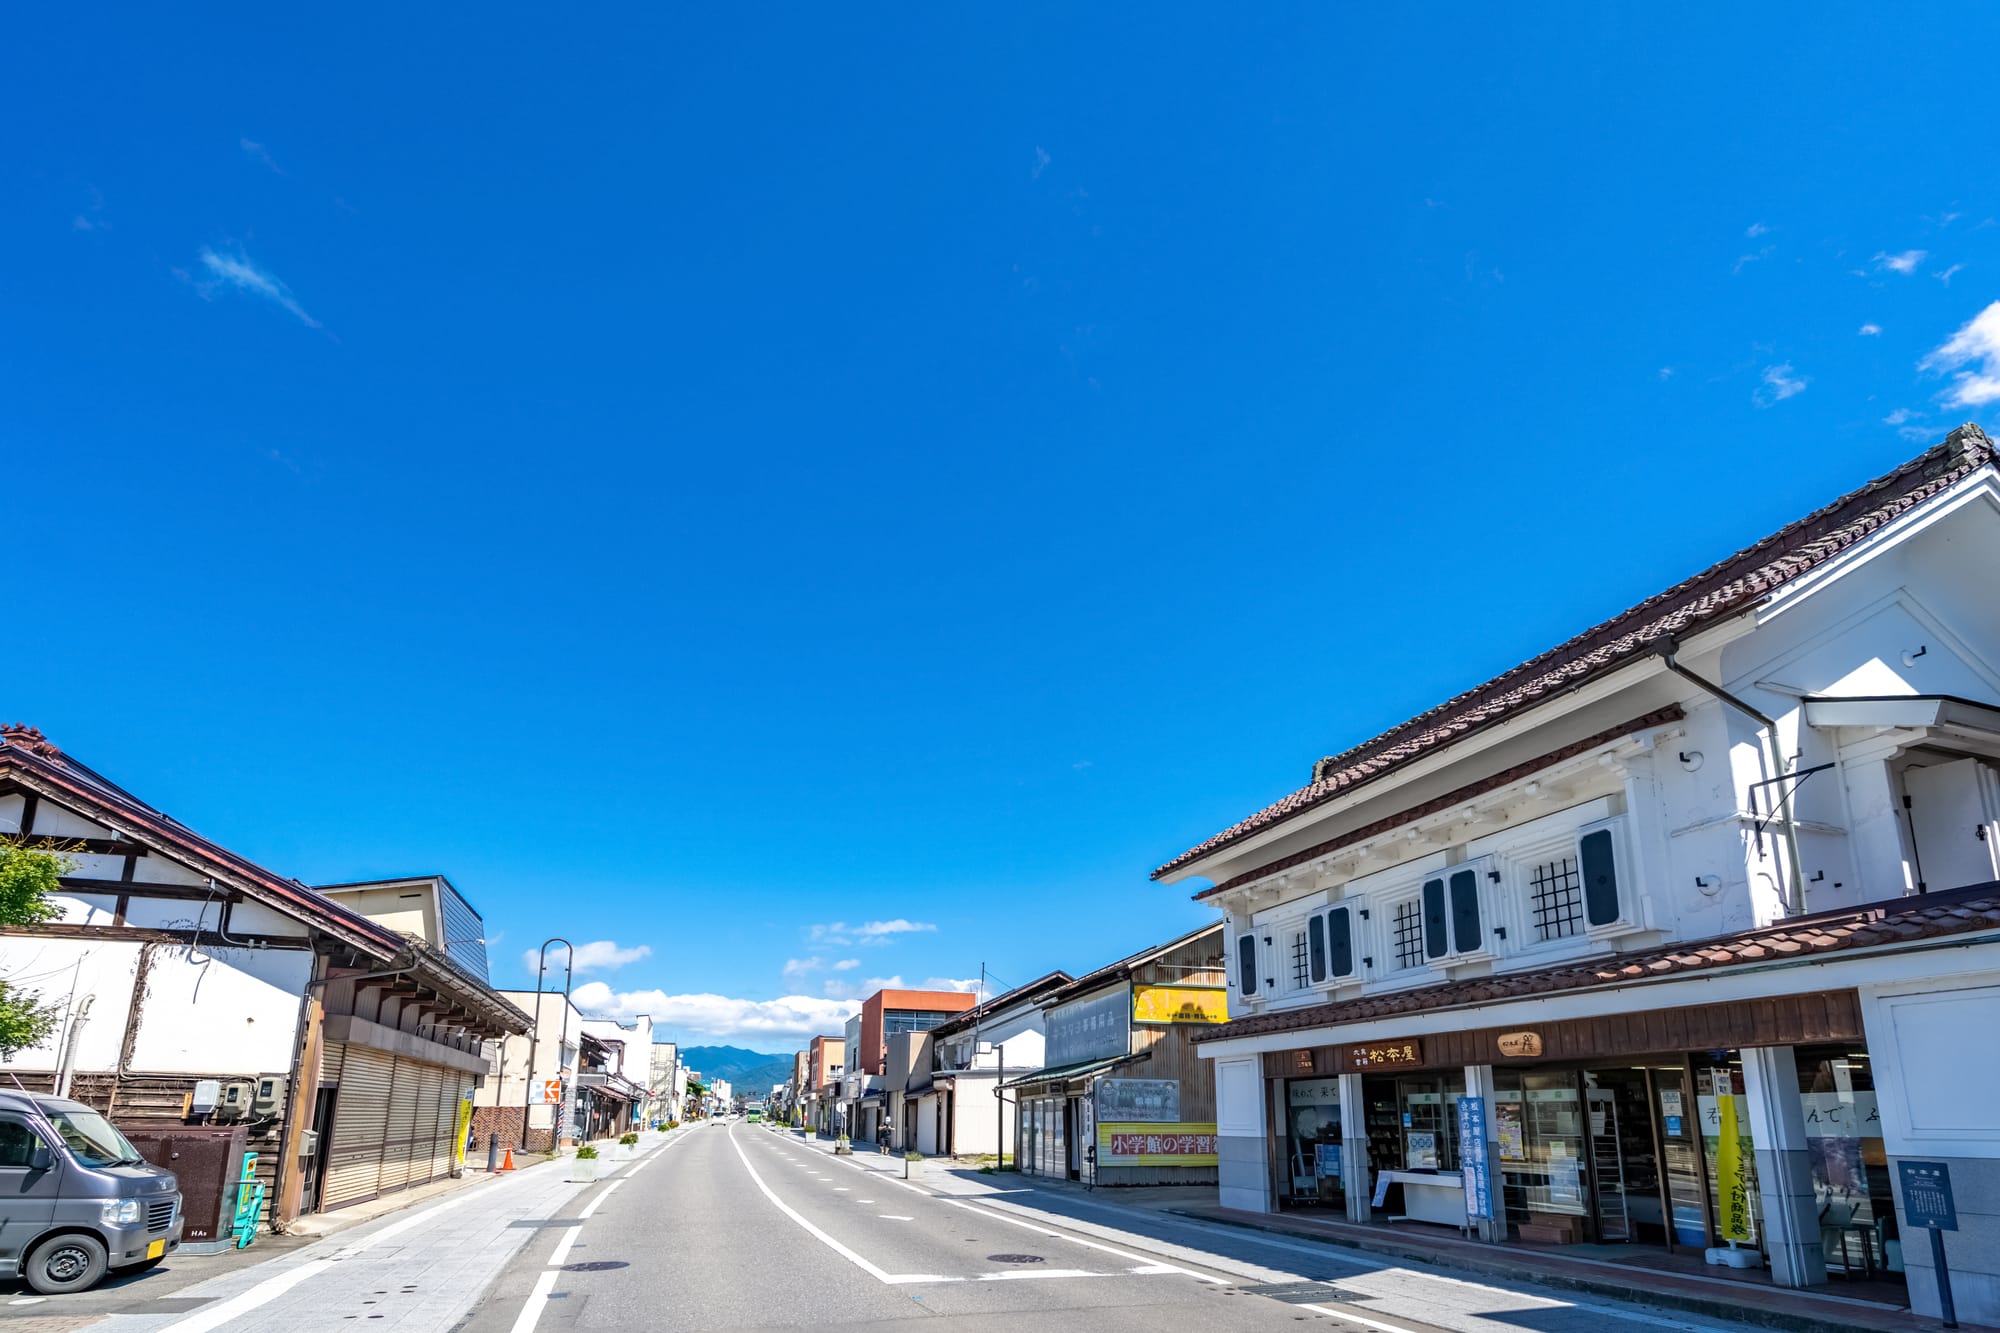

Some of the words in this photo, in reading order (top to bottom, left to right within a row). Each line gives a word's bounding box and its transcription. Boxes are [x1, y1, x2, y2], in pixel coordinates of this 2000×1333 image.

[1369, 1045, 1415, 1064] 松本屋
[1112, 1135, 1217, 1154] 小学館の学習
